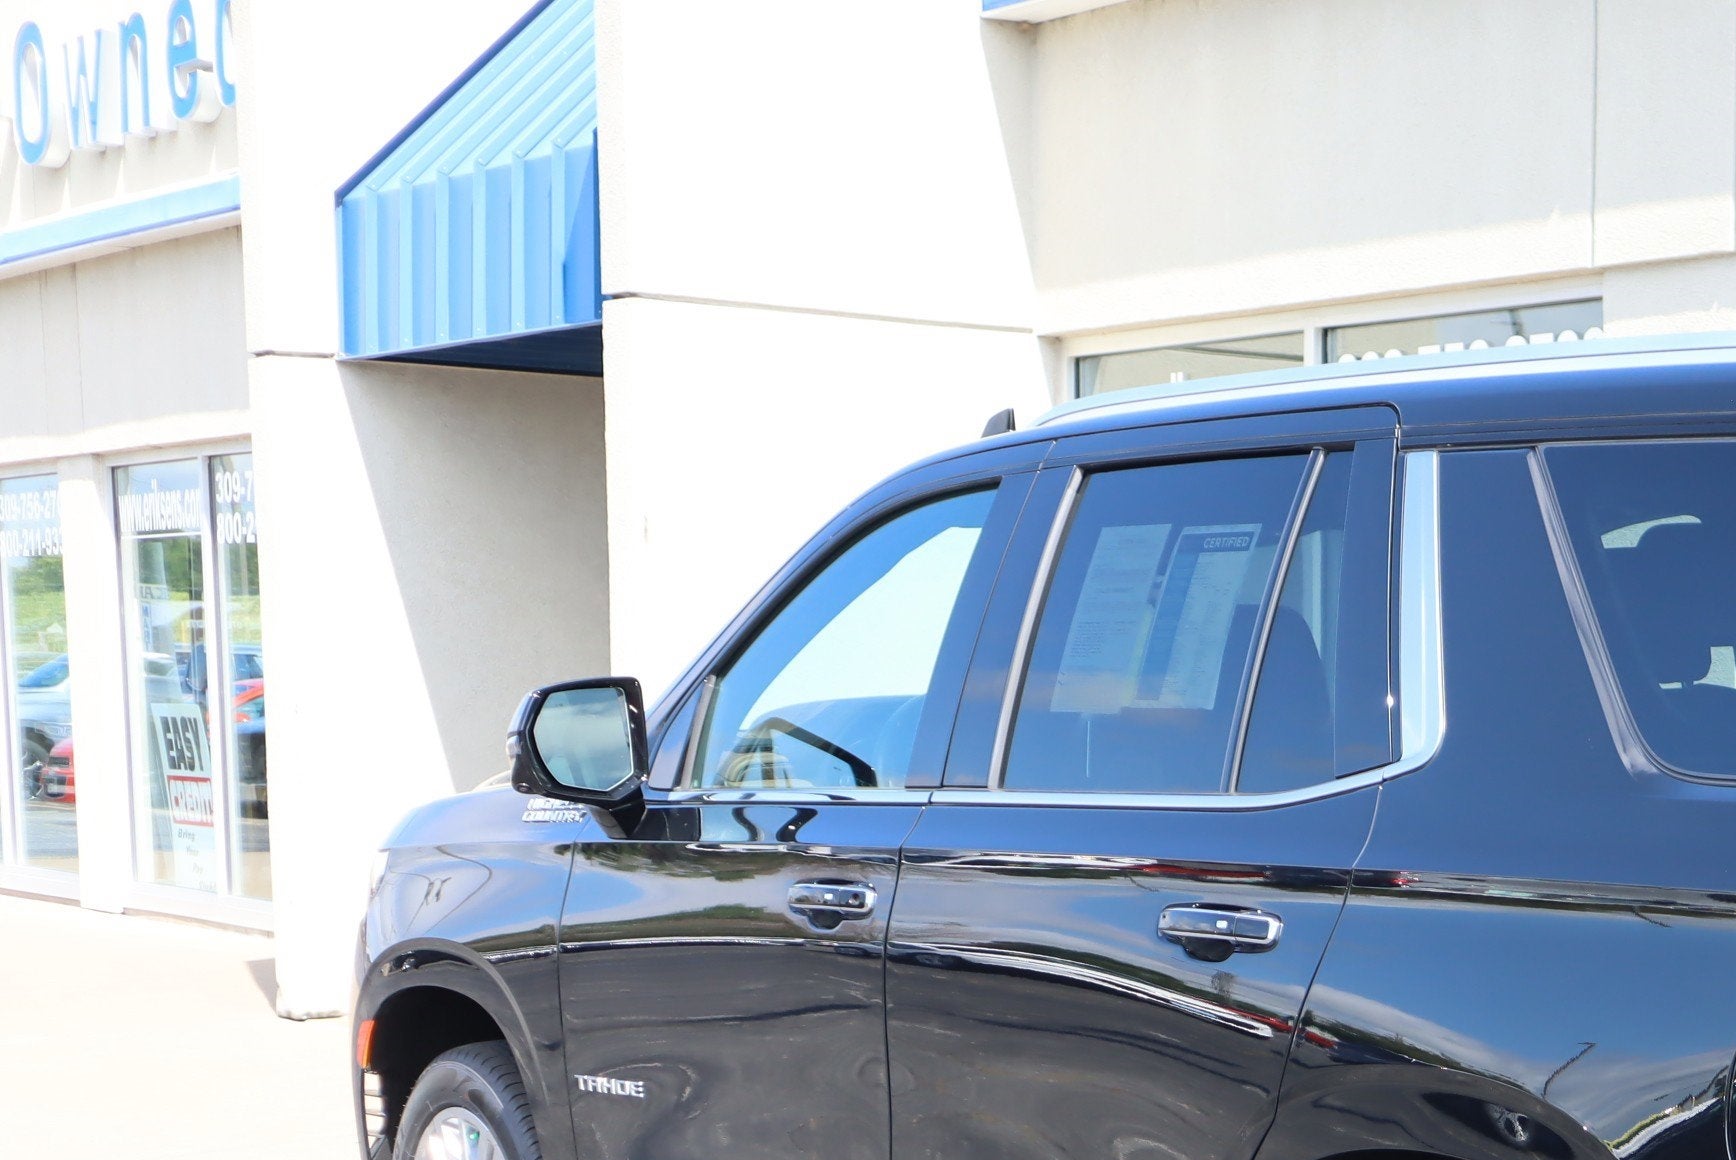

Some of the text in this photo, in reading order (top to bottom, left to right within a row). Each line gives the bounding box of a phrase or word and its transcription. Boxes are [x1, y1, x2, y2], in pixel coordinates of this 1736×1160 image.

[1203, 536, 1250, 549] CERTIFIED
[160, 716, 204, 772] EASY
[573, 1074, 645, 1098] TAHOE
